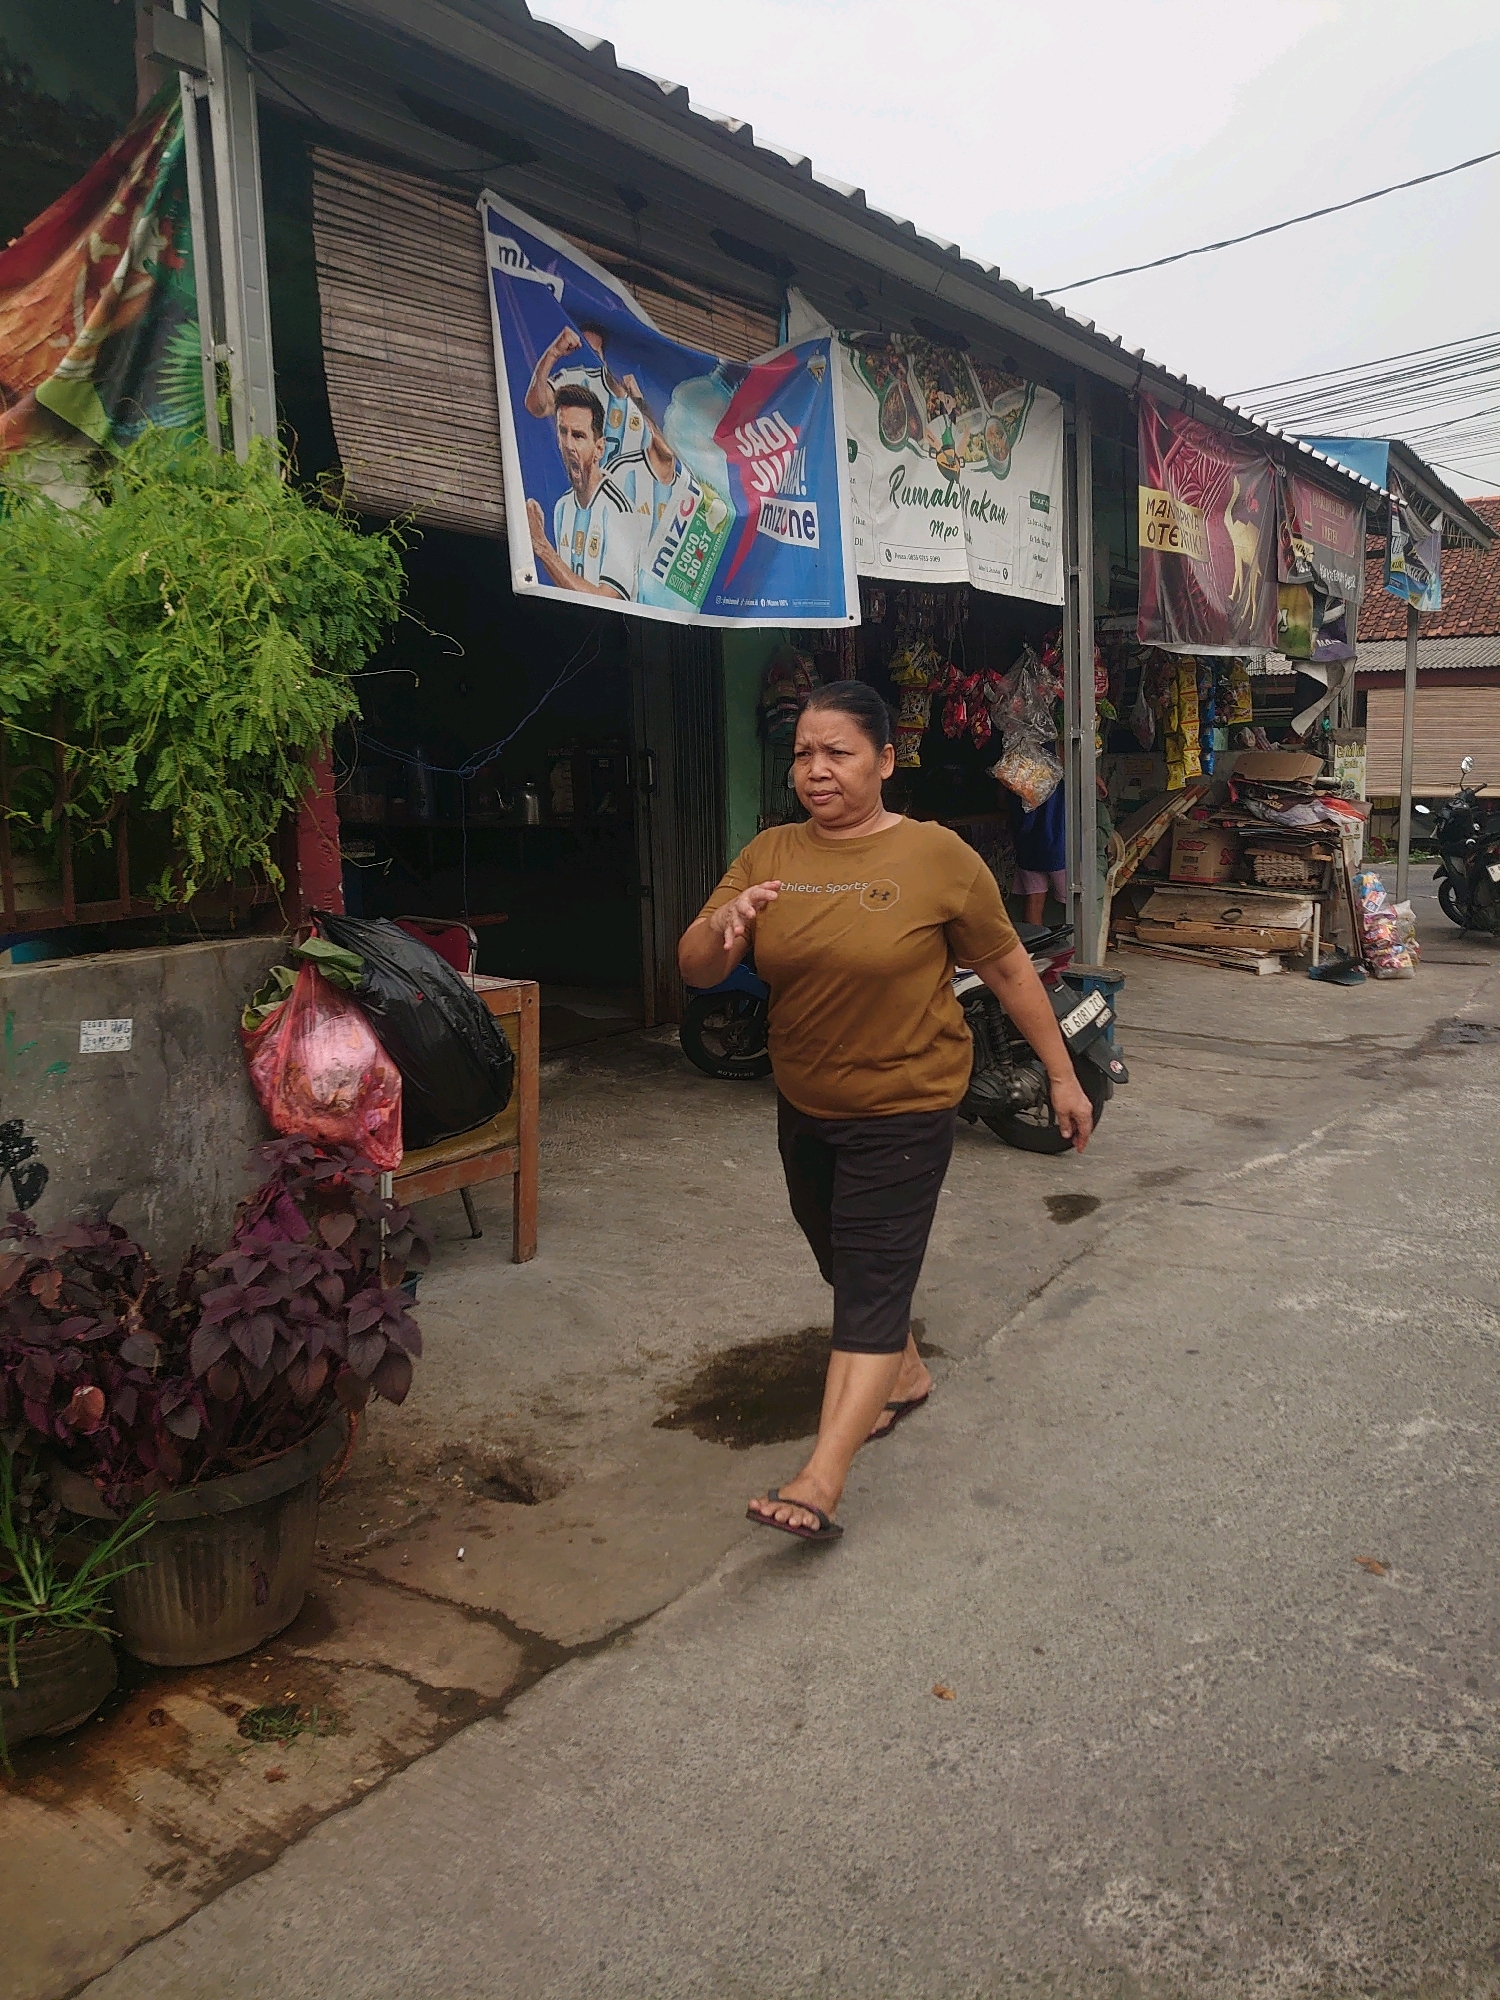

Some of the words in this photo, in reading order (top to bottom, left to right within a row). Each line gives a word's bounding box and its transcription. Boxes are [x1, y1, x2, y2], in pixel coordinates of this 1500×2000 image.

[734, 410, 798, 458] JADI
[889, 464, 960, 510] Rumah
[760, 503, 816, 541] mizone
[929, 519, 959, 542] Mpo
[676, 533, 700, 573] COCO
[780, 882, 823, 894] thletic
[825, 881, 869, 894] Sports
[1063, 1022, 1073, 1036] B
[1072, 1006, 1092, 1028] 6081
